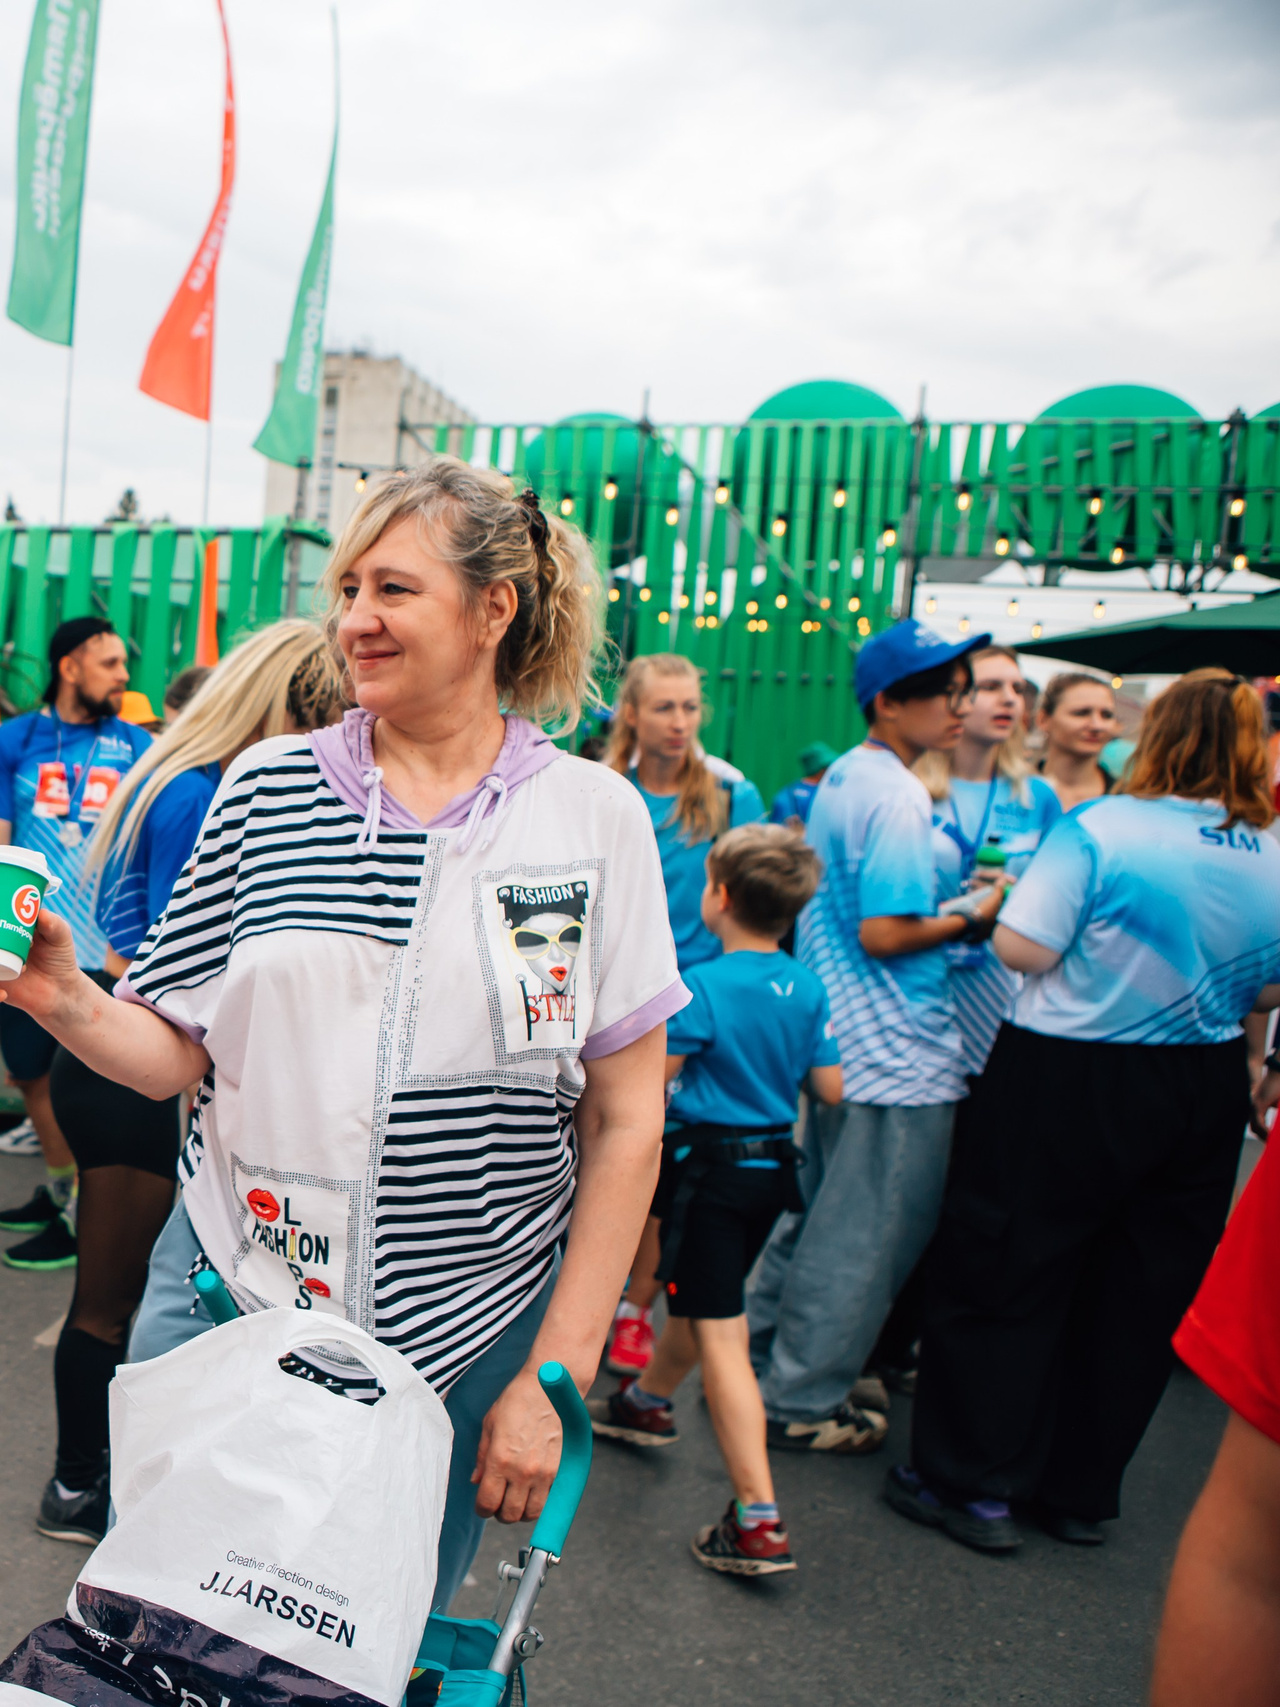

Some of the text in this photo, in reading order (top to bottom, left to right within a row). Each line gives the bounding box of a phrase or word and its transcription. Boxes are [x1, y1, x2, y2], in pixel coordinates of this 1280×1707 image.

[512, 884, 574, 905] FASHION
[226, 1549, 350, 1607] Creative direction design
[199, 1571, 356, 1649] J.LARSSEN
